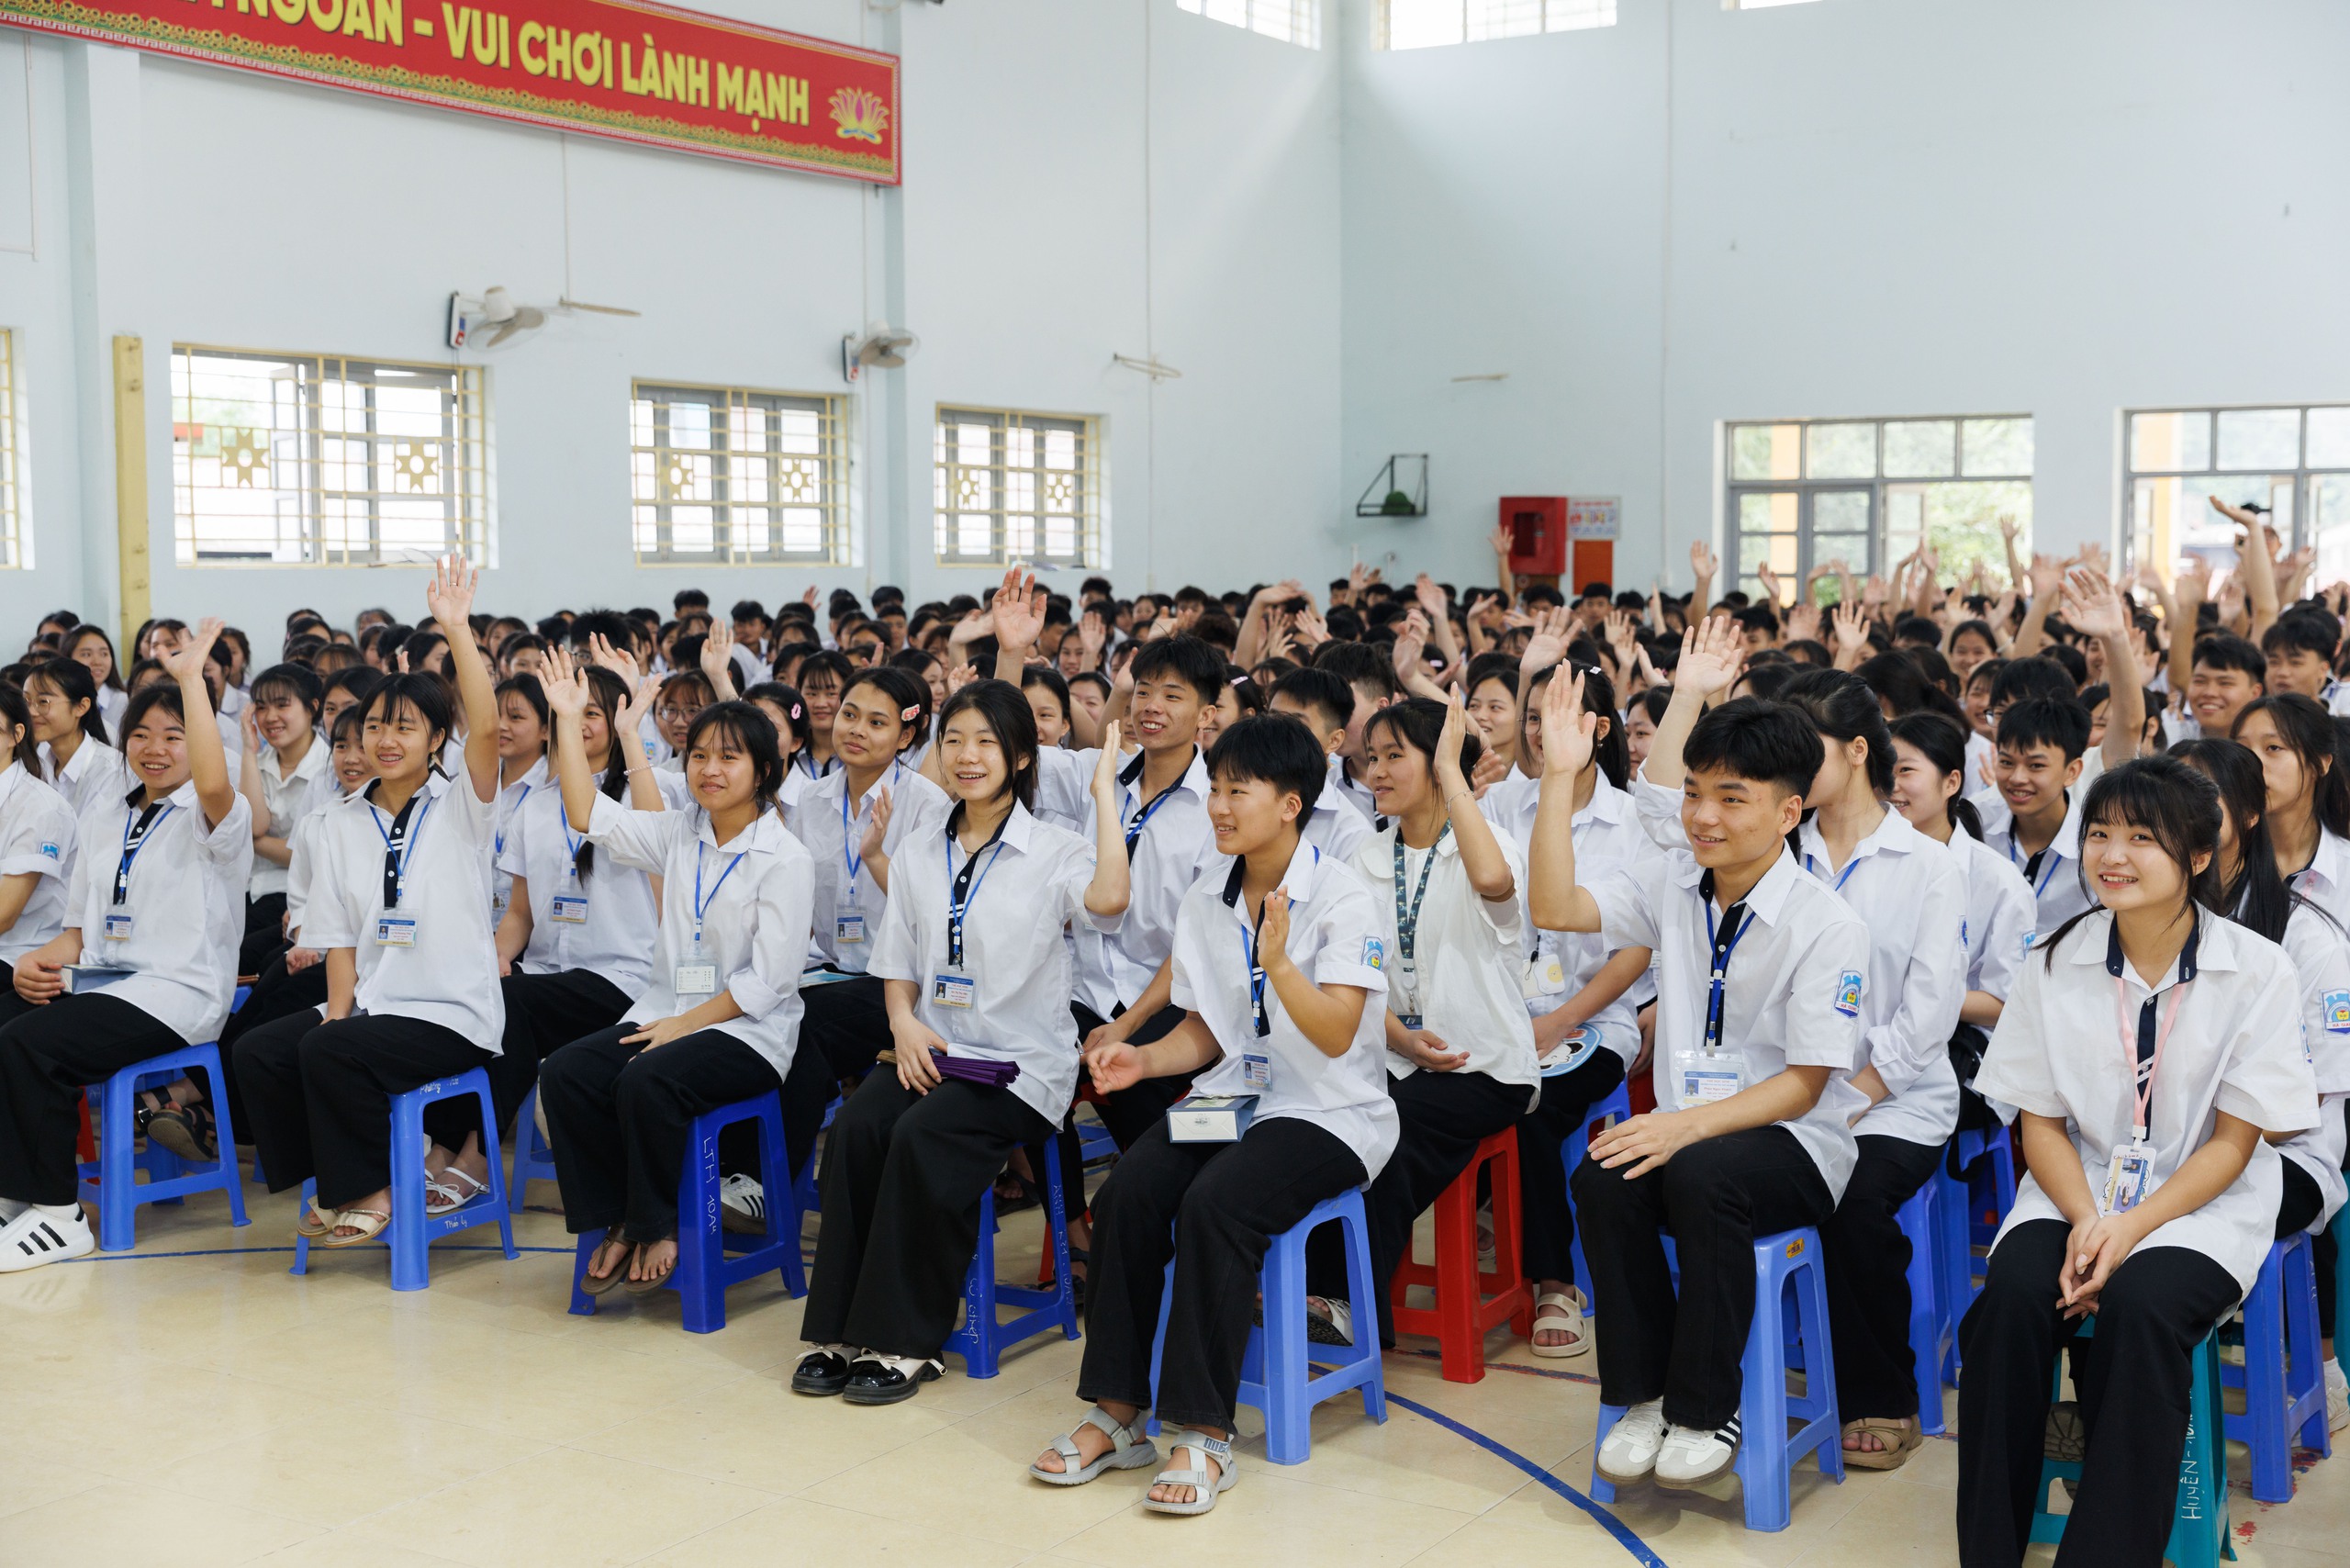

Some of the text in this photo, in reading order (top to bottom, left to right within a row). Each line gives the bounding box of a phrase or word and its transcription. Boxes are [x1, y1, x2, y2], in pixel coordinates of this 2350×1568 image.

[237, 0, 404, 47] OAN
[441, 1, 510, 69] VUI
[518, 20, 614, 90] CHƠI
[621, 32, 711, 109] LÀNH
[716, 61, 810, 133] MẠNH
